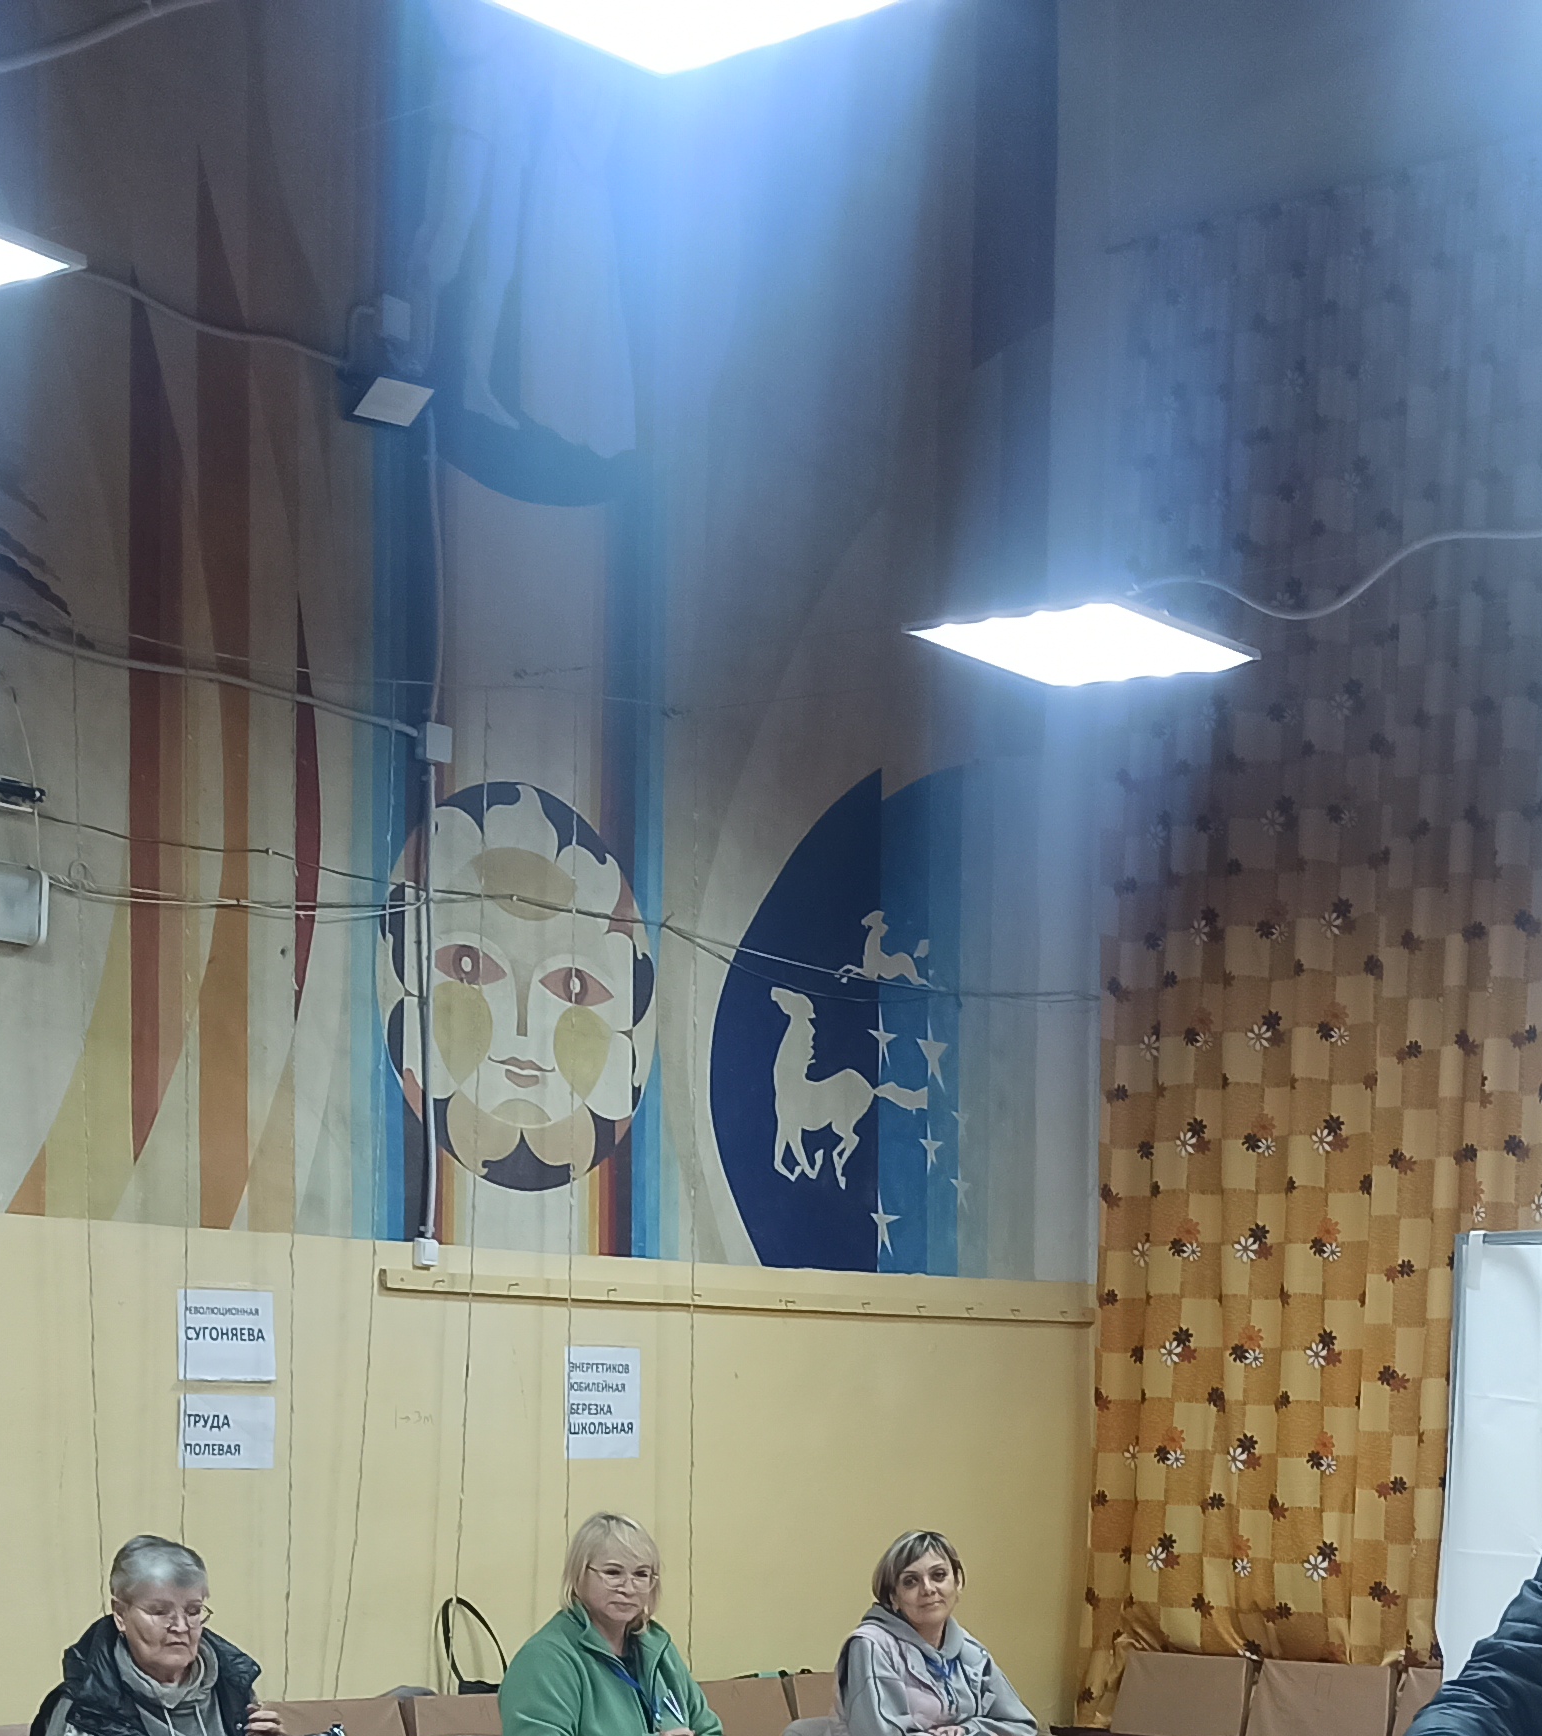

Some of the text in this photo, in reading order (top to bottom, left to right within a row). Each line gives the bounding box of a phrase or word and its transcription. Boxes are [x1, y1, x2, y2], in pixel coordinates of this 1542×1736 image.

[185, 1325, 266, 1342] СУГОНЯЕВА
[569, 1361, 630, 1374] ЭНЕРГЕТИКОВ
[569, 1379, 626, 1393] ЮБИЛЕЙНАЯ
[569, 1402, 613, 1416] БЕРЕЗКА
[187, 1413, 232, 1432] ТРУДА
[569, 1421, 634, 1435] ШКОЛЬНАЯ
[184, 1442, 241, 1457] ПОЛЕВАЯ
